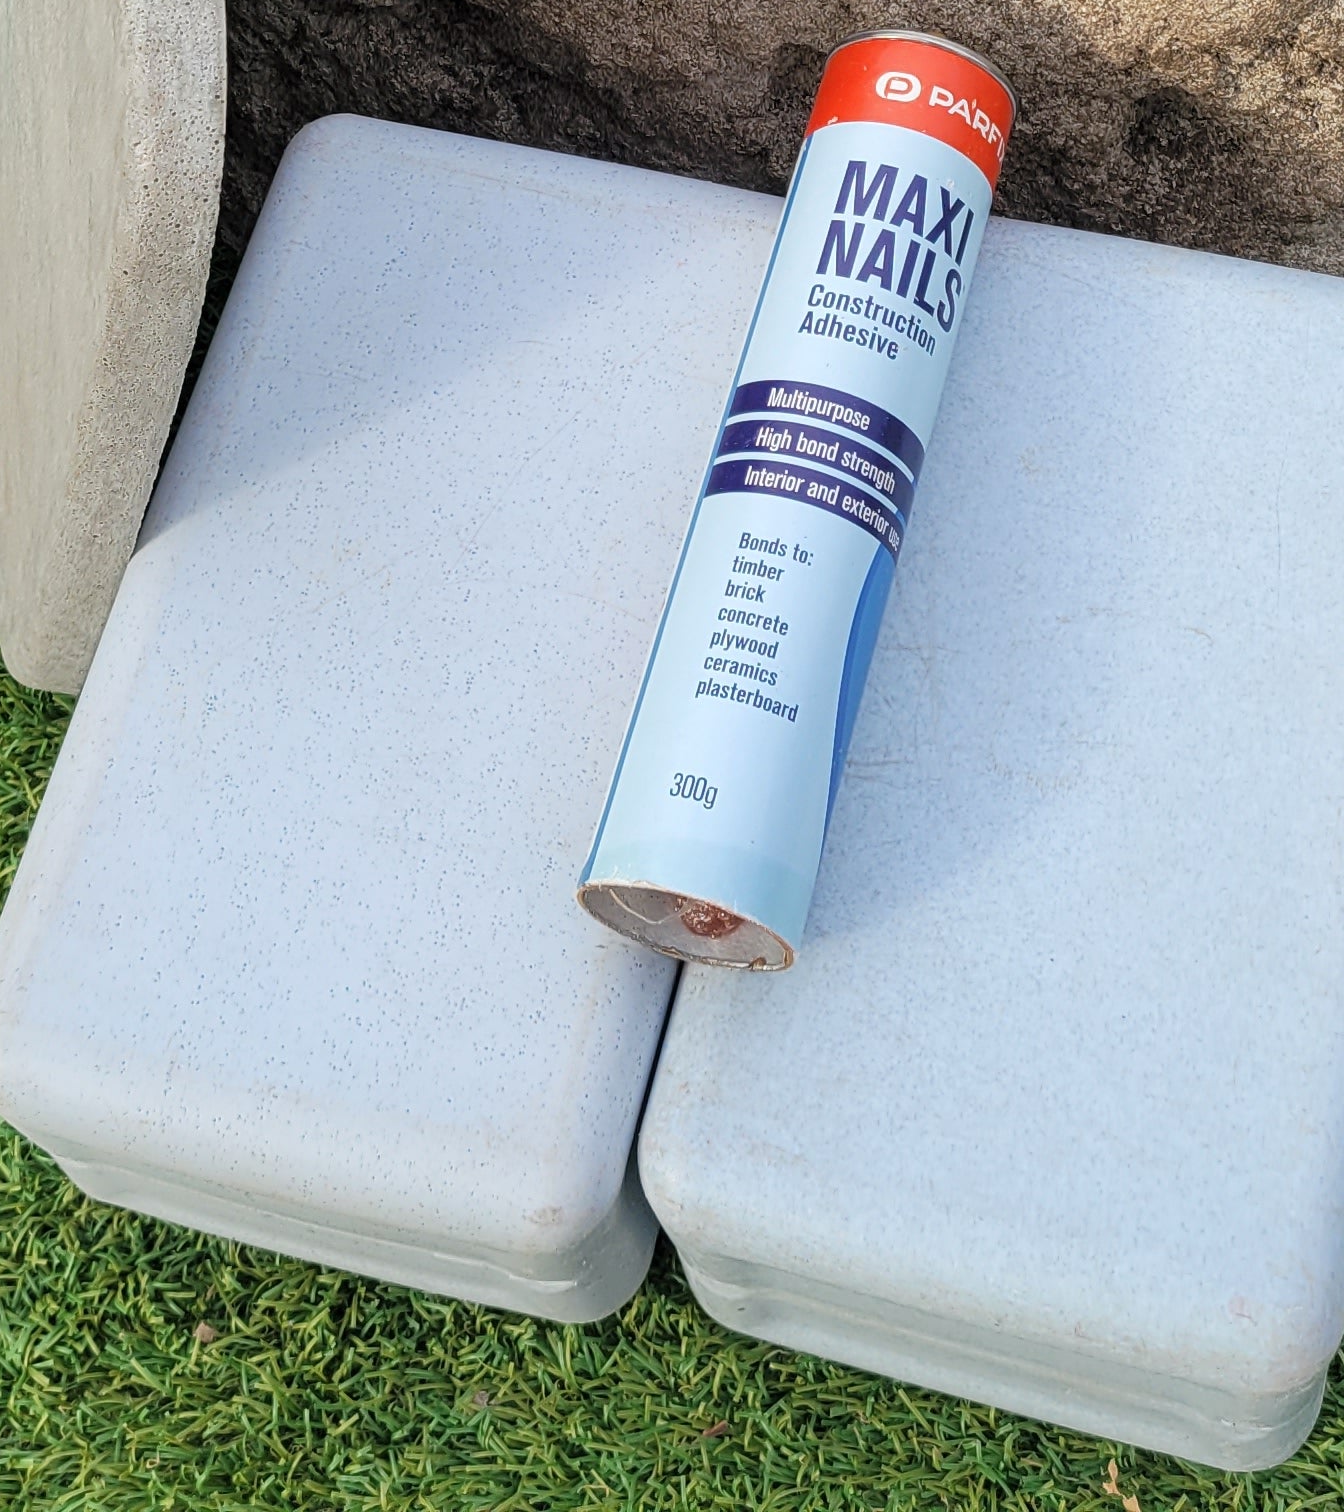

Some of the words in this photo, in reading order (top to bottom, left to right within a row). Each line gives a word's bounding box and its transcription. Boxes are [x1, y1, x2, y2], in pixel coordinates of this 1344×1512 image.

[833, 160, 975, 268] MAXI
[815, 220, 962, 333] NAILS
[798, 311, 899, 360] Adhesive
[807, 284, 936, 357] Construction
[766, 387, 870, 431] Multipurpose
[755, 427, 791, 451] High
[796, 431, 840, 462] bond
[841, 450, 896, 495] strength
[744, 466, 805, 493] Interior
[806, 479, 841, 506] and
[842, 495, 889, 536] exterior
[732, 556, 786, 583] timber
[738, 532, 788, 558] Bonds
[792, 542, 815, 567] to:
[724, 579, 767, 604] brick
[717, 605, 790, 637] concrete
[709, 629, 780, 660] plywood
[703, 654, 779, 687] ceramics
[695, 678, 800, 724] plasterboard
[669, 772, 718, 810] 300g
